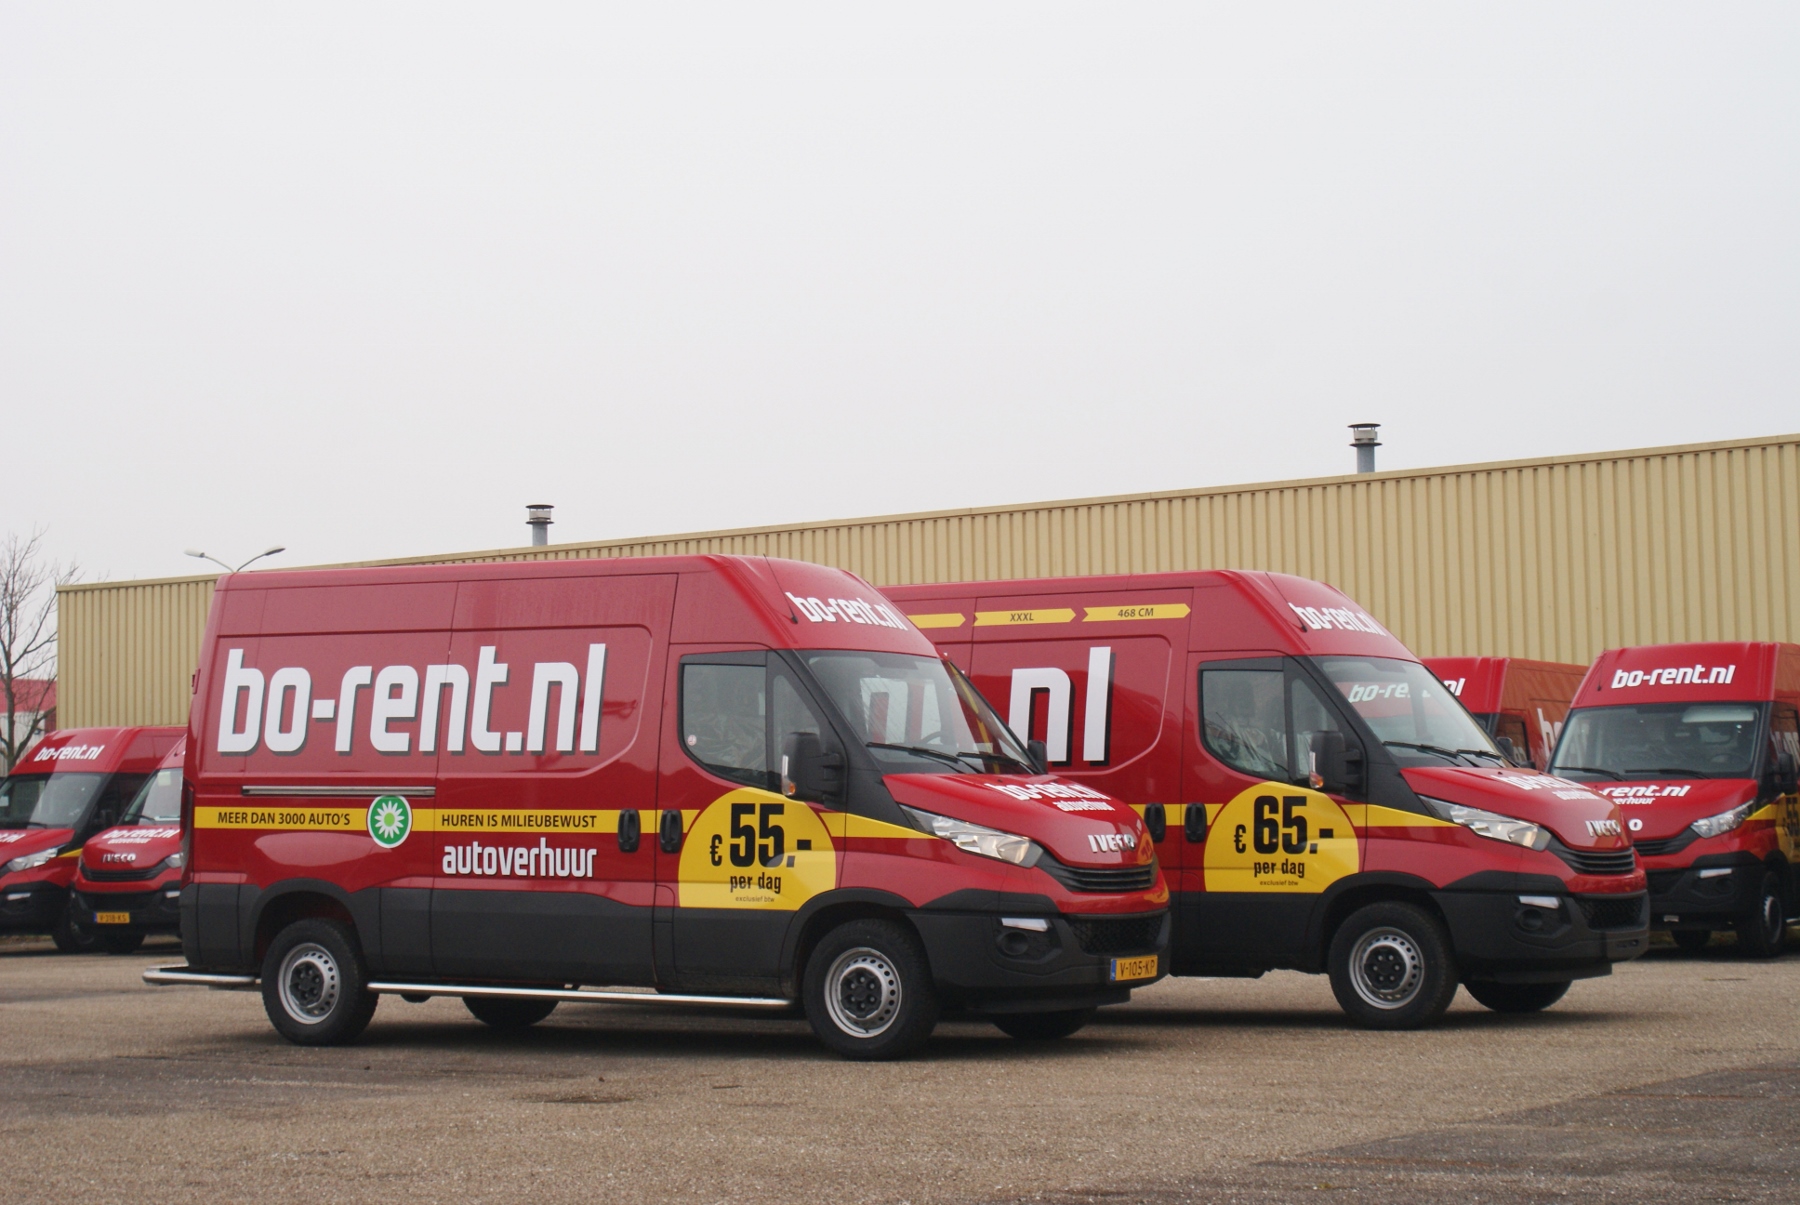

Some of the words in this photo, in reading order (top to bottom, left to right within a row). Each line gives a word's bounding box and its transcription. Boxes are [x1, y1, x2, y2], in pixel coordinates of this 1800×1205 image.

[785, 592, 909, 631] bo-rent.nl
[1010, 613, 1034, 622] XXXL
[1118, 609, 1136, 618] 468
[1138, 608, 1154, 617] CM
[1288, 602, 1387, 636] bo-rent.nl
[1611, 664, 1736, 689] bo-rent.nl
[217, 643, 607, 756] bo-rent.nl
[34, 745, 105, 762] bo-rent.nl
[1598, 784, 1692, 797] -rent.nl
[218, 812, 248, 824] MEER
[250, 812, 275, 825] DAN
[278, 813, 306, 825] 3000
[308, 813, 351, 826] AUTO'S
[441, 814, 484, 827] HUREN
[487, 814, 498, 827] IS
[501, 815, 597, 828] MILIEUBEWUST
[1585, 820, 1622, 837] IVECO
[1088, 834, 1136, 853] IVECO
[102, 853, 137, 863] IVECO
[442, 837, 597, 879] autoverhuur
[1254, 862, 1276, 878] per
[1281, 858, 1305, 878] dag
[730, 875, 752, 893] per
[758, 871, 781, 894] dag
[1120, 959, 1155, 977] V-105-KP
